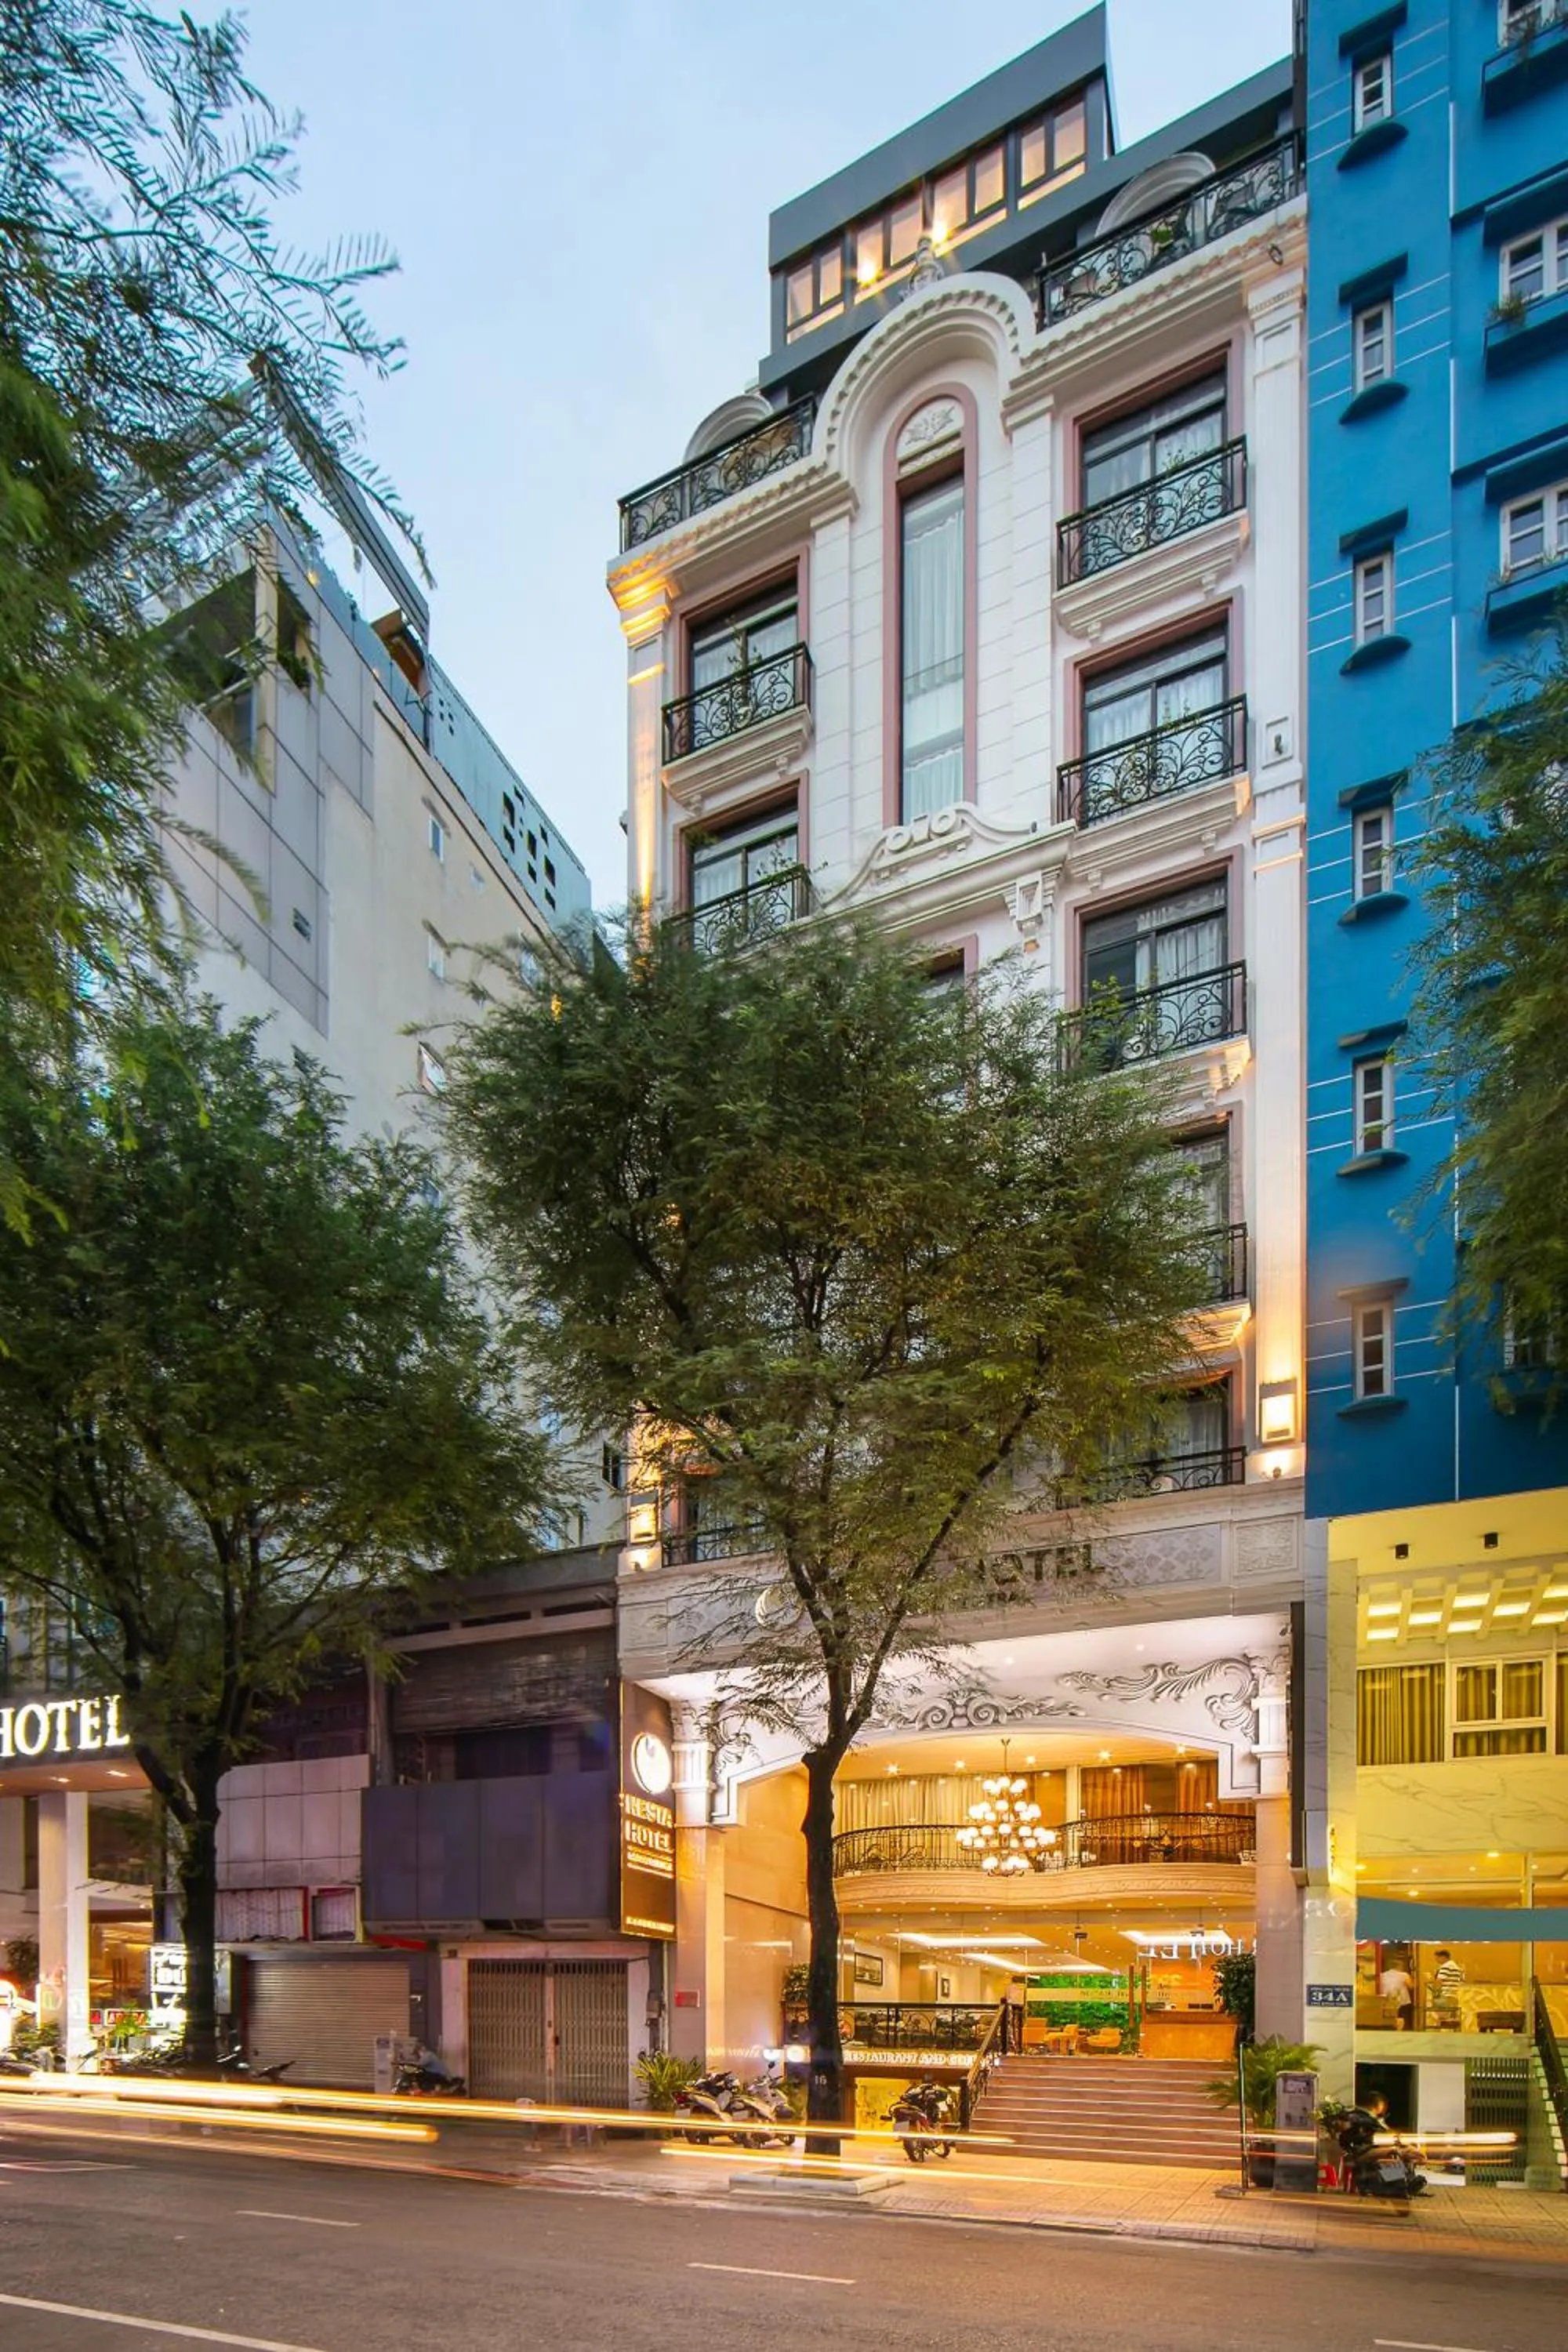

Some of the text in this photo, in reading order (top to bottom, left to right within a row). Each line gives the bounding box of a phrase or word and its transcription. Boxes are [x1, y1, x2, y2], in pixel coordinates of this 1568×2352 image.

[972, 1544, 1105, 1586] OTEL
[626, 1820, 674, 1853] HOTEL
[1312, 1992, 1348, 2002] 34A
